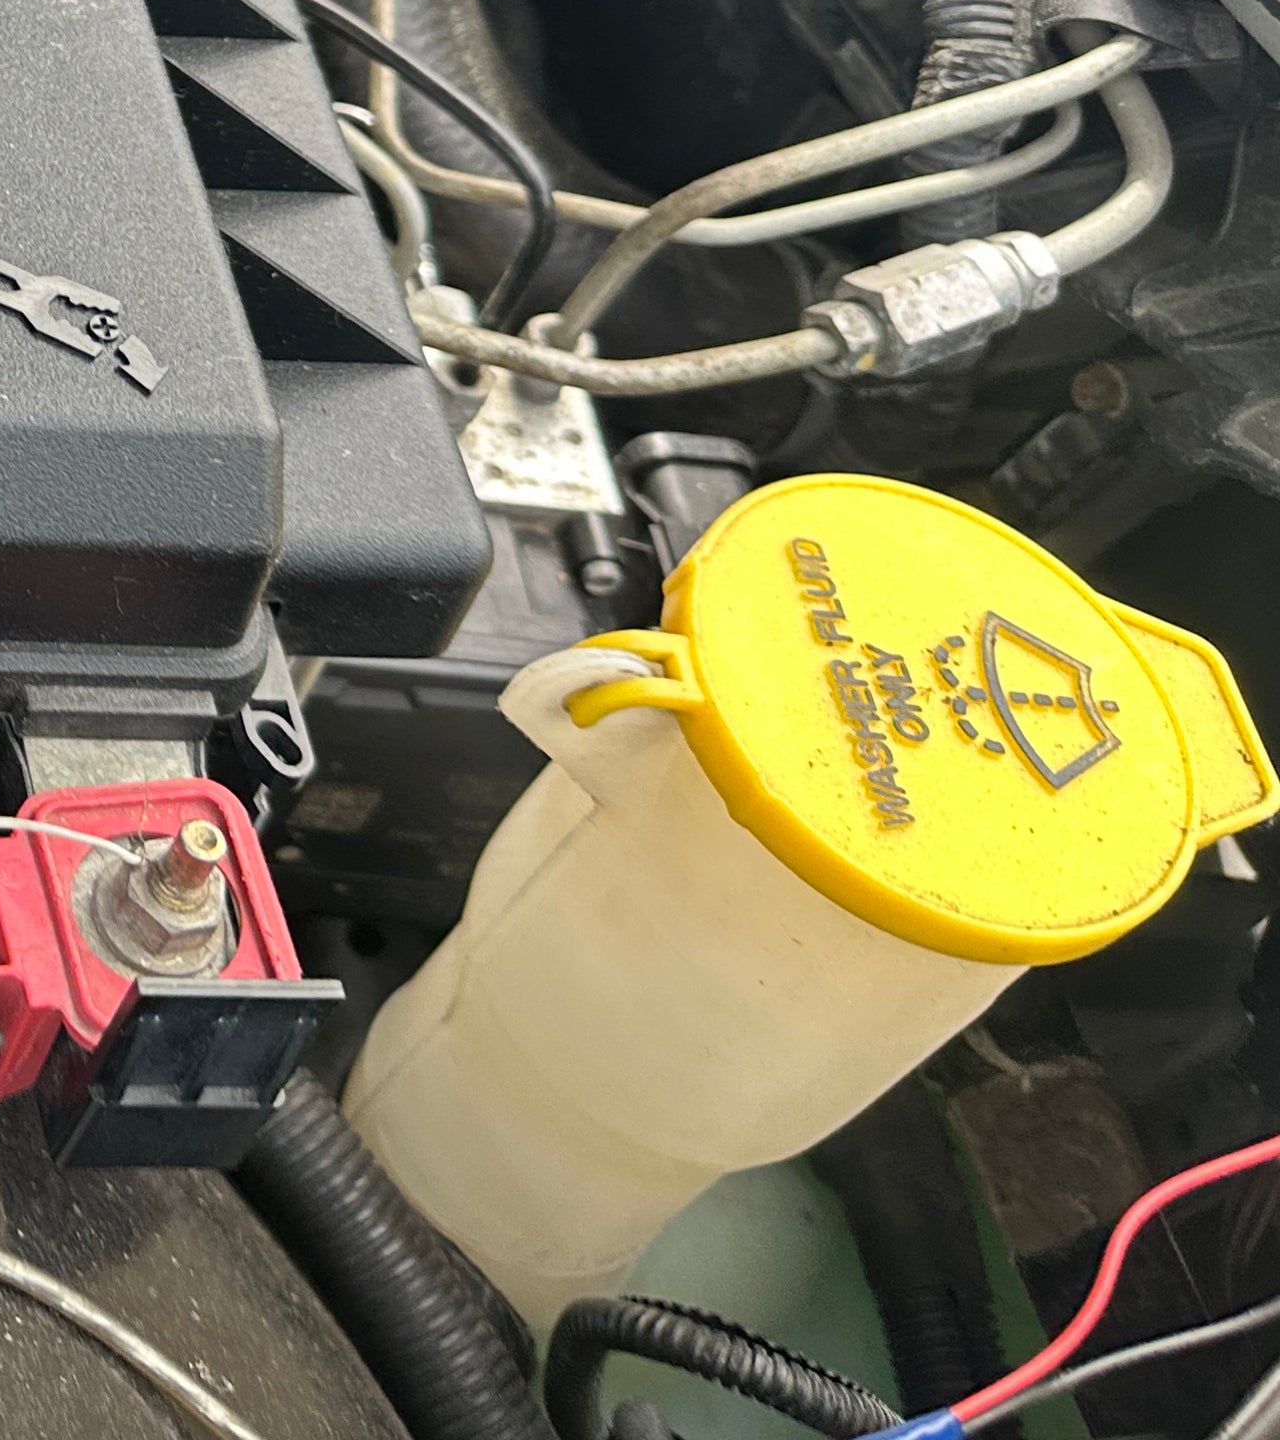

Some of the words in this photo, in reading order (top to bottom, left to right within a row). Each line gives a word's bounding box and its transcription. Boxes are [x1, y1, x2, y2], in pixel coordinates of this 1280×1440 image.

[788, 537, 854, 647] FLUID
[827, 658, 916, 829] WASHER
[862, 642, 931, 744] ONLY
